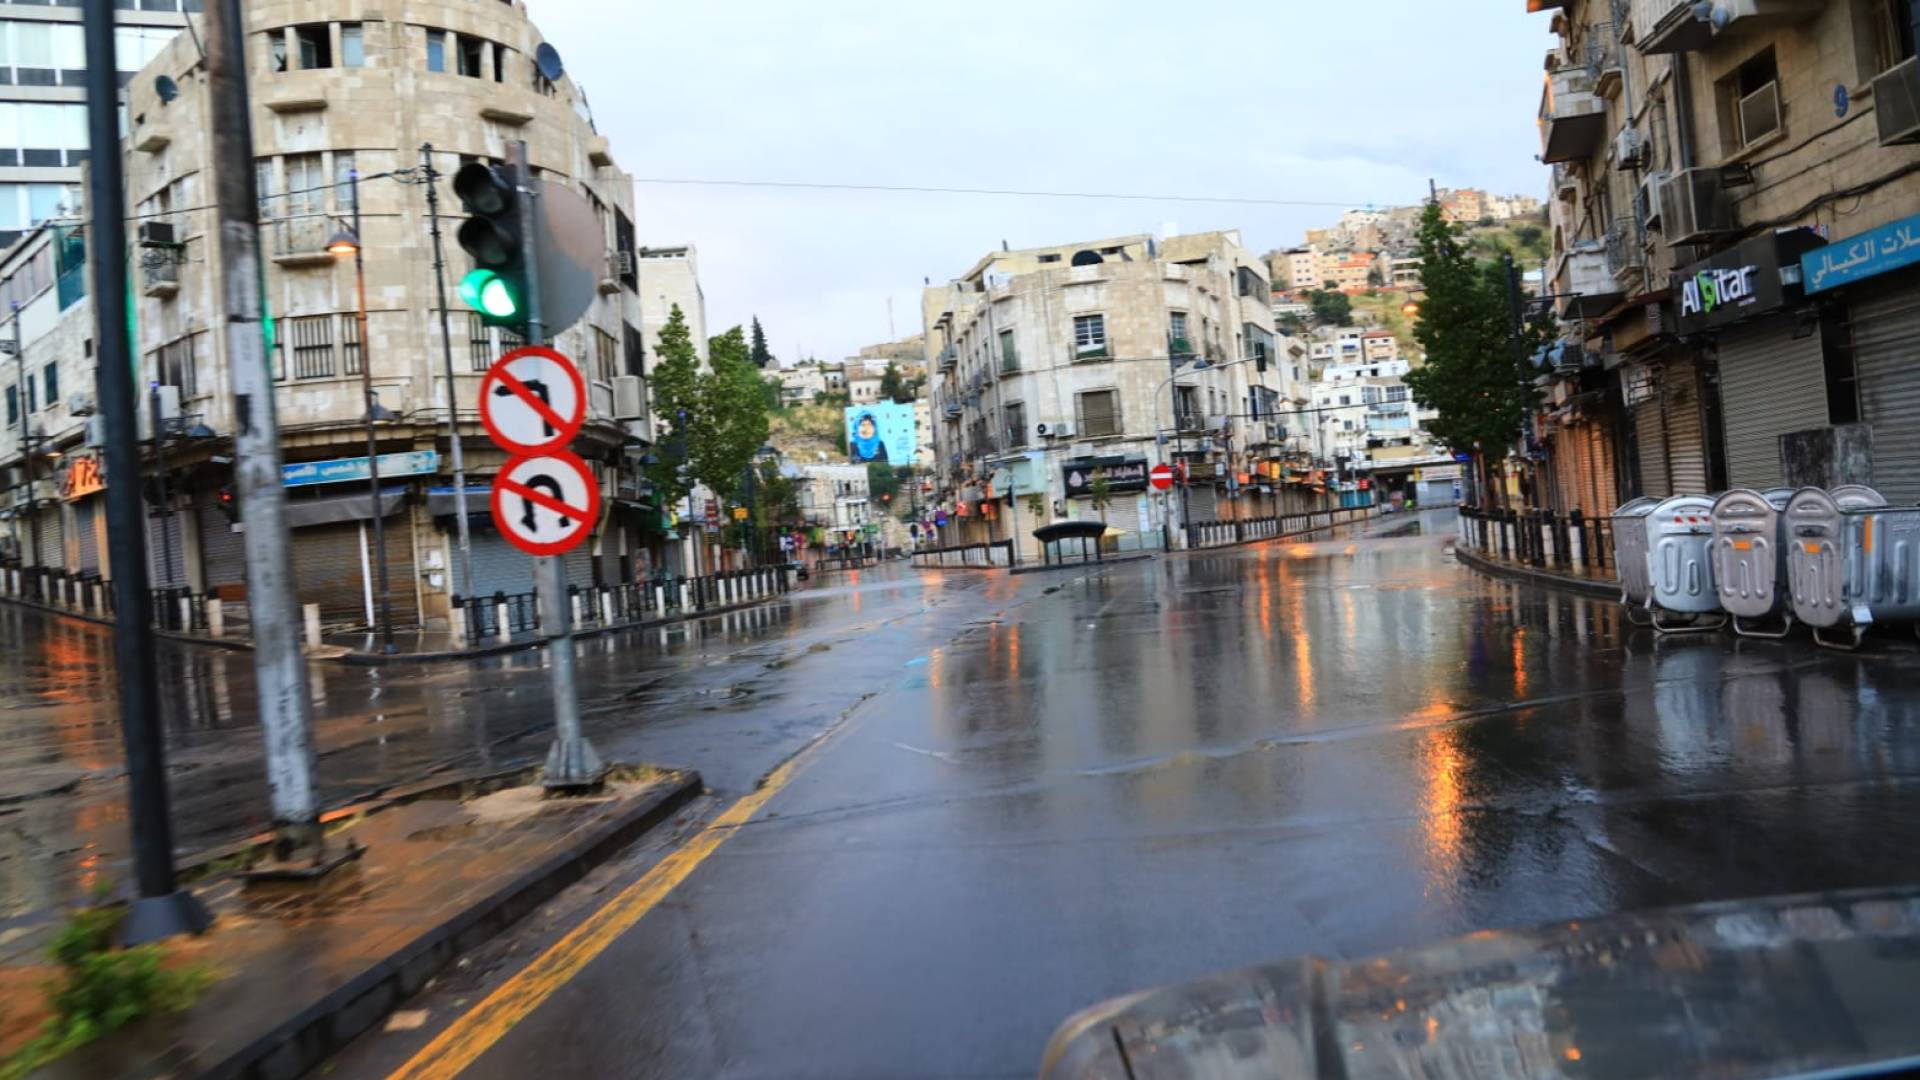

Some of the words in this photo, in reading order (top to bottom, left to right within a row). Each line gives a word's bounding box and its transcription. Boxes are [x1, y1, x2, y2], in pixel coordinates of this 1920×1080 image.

[1834, 84, 1849, 118] 9
[1881, 226, 1920, 256] لات
[1811, 240, 1875, 289] الكيالي
